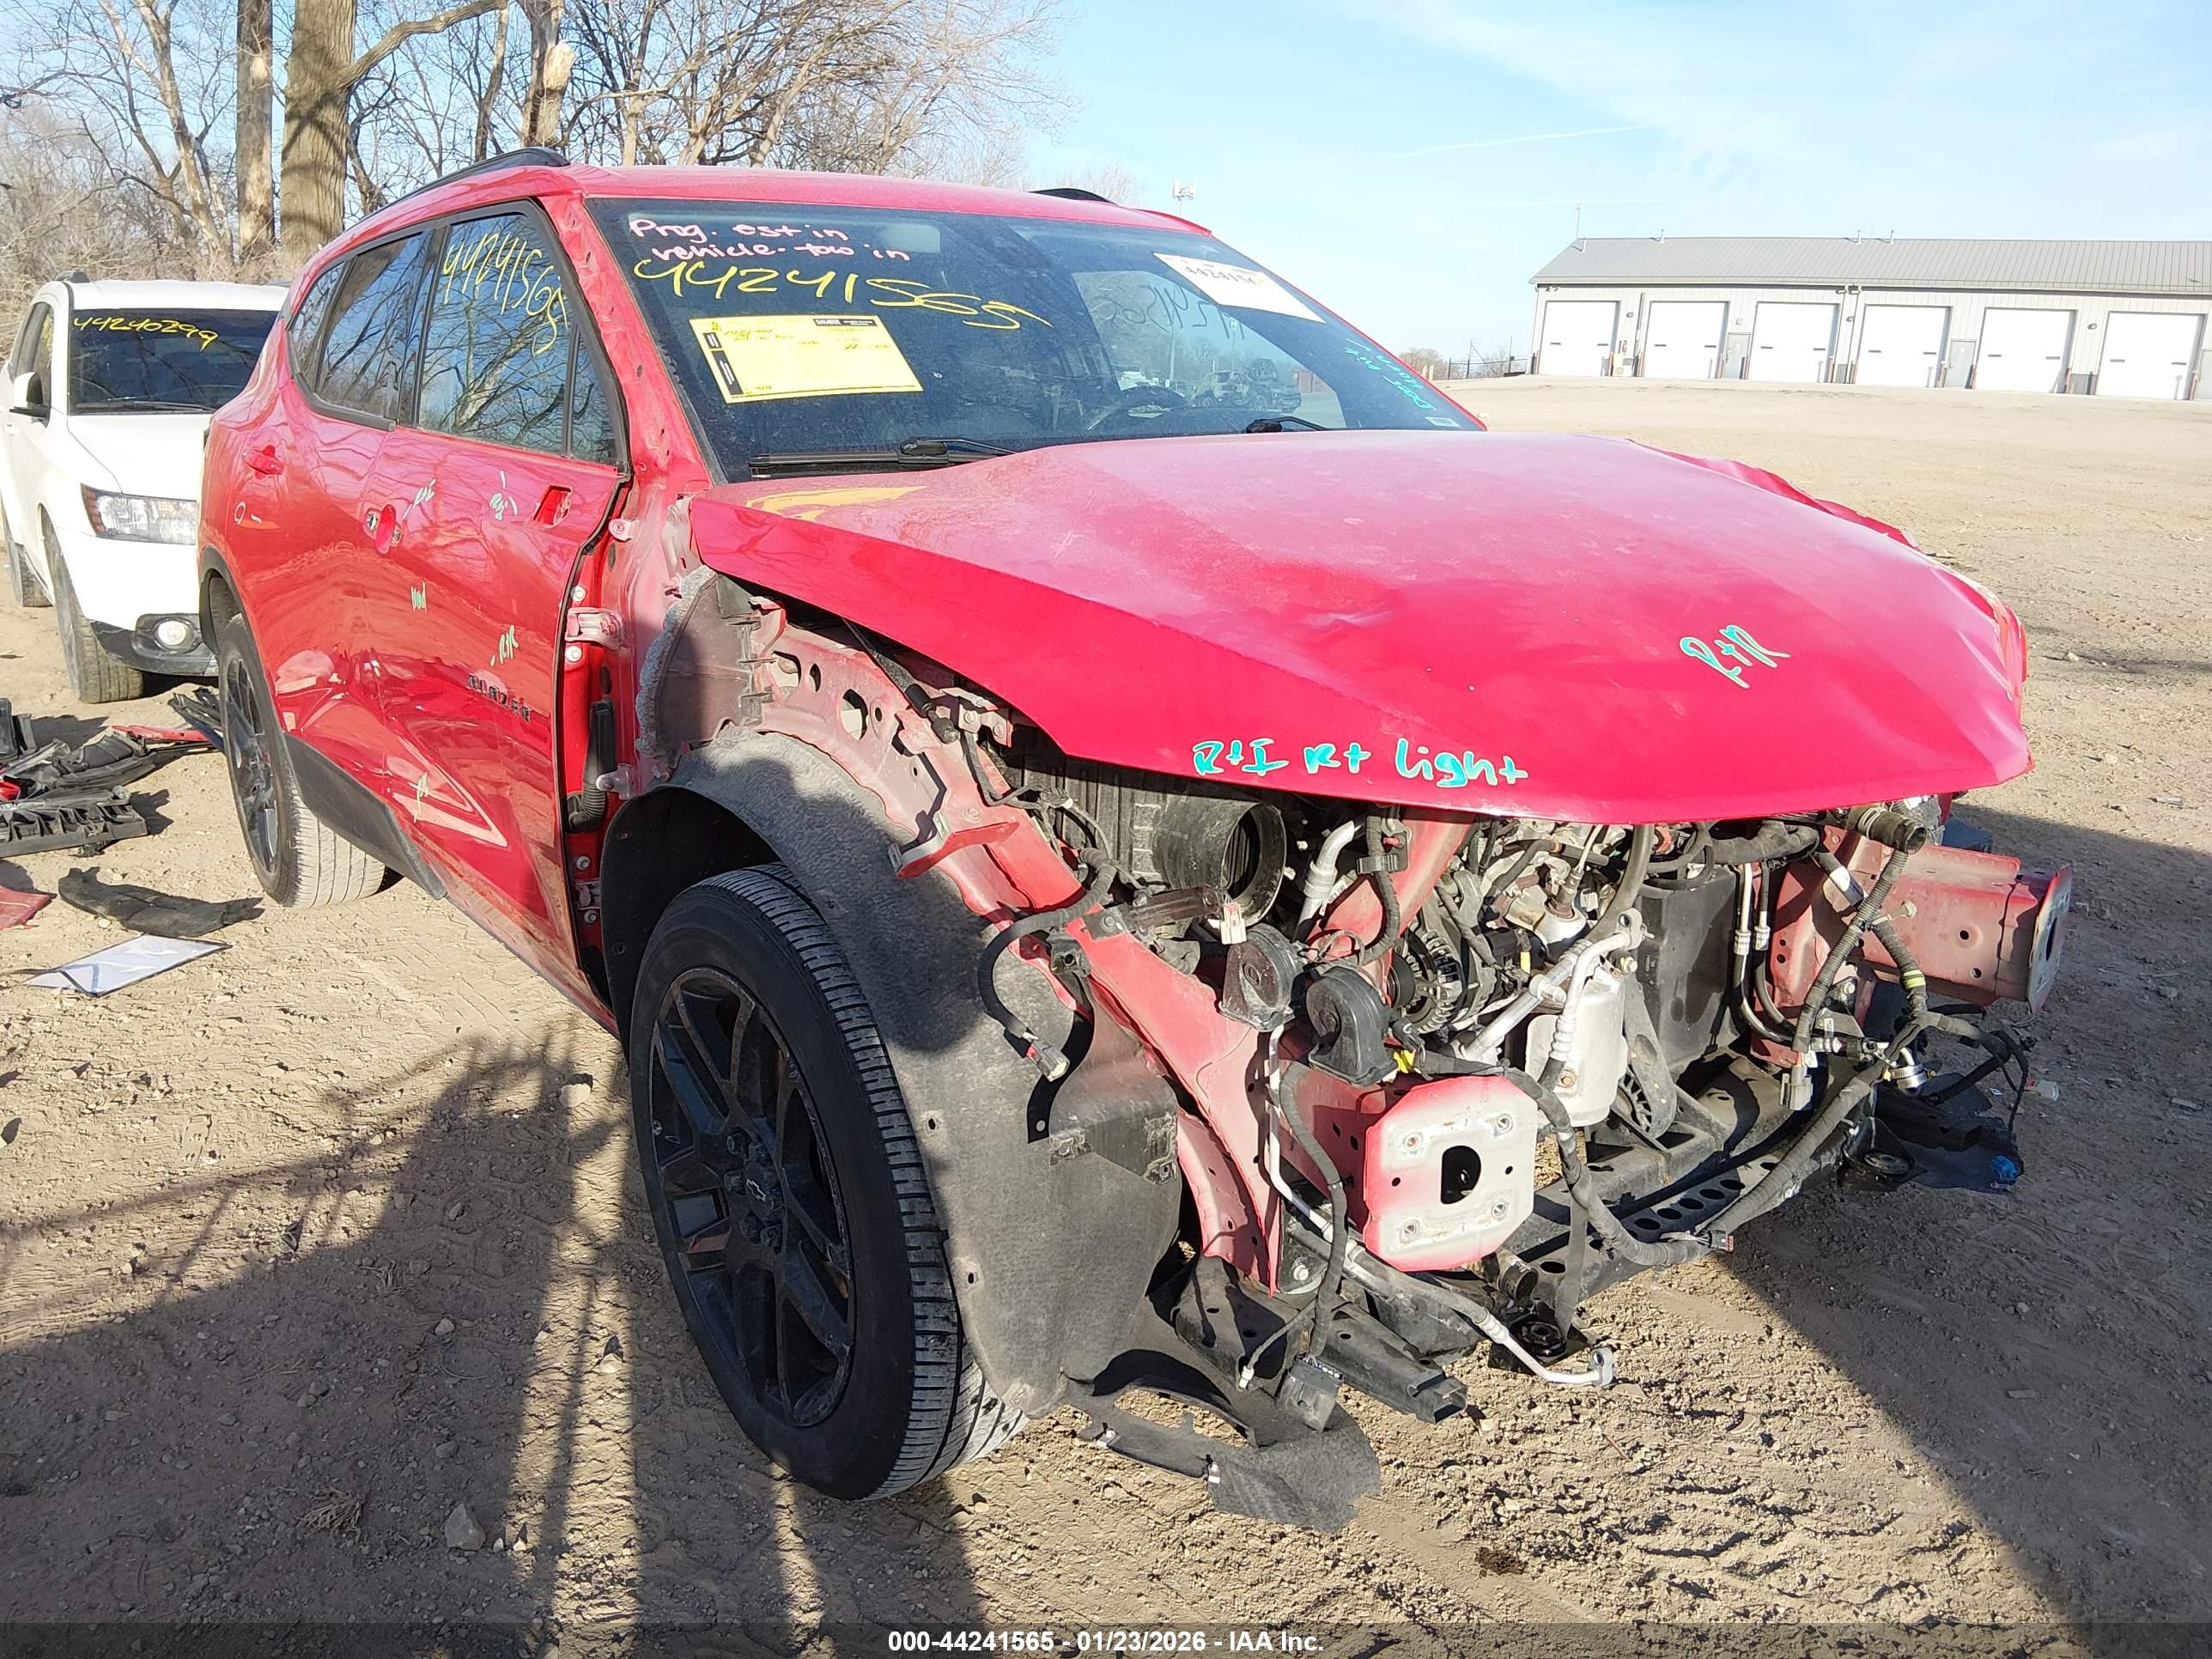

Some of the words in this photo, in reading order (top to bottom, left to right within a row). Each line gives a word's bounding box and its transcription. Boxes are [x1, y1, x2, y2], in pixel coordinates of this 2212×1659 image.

[804, 223, 848, 241] in
[863, 243, 910, 261] in
[74, 316, 219, 352] 44240299
